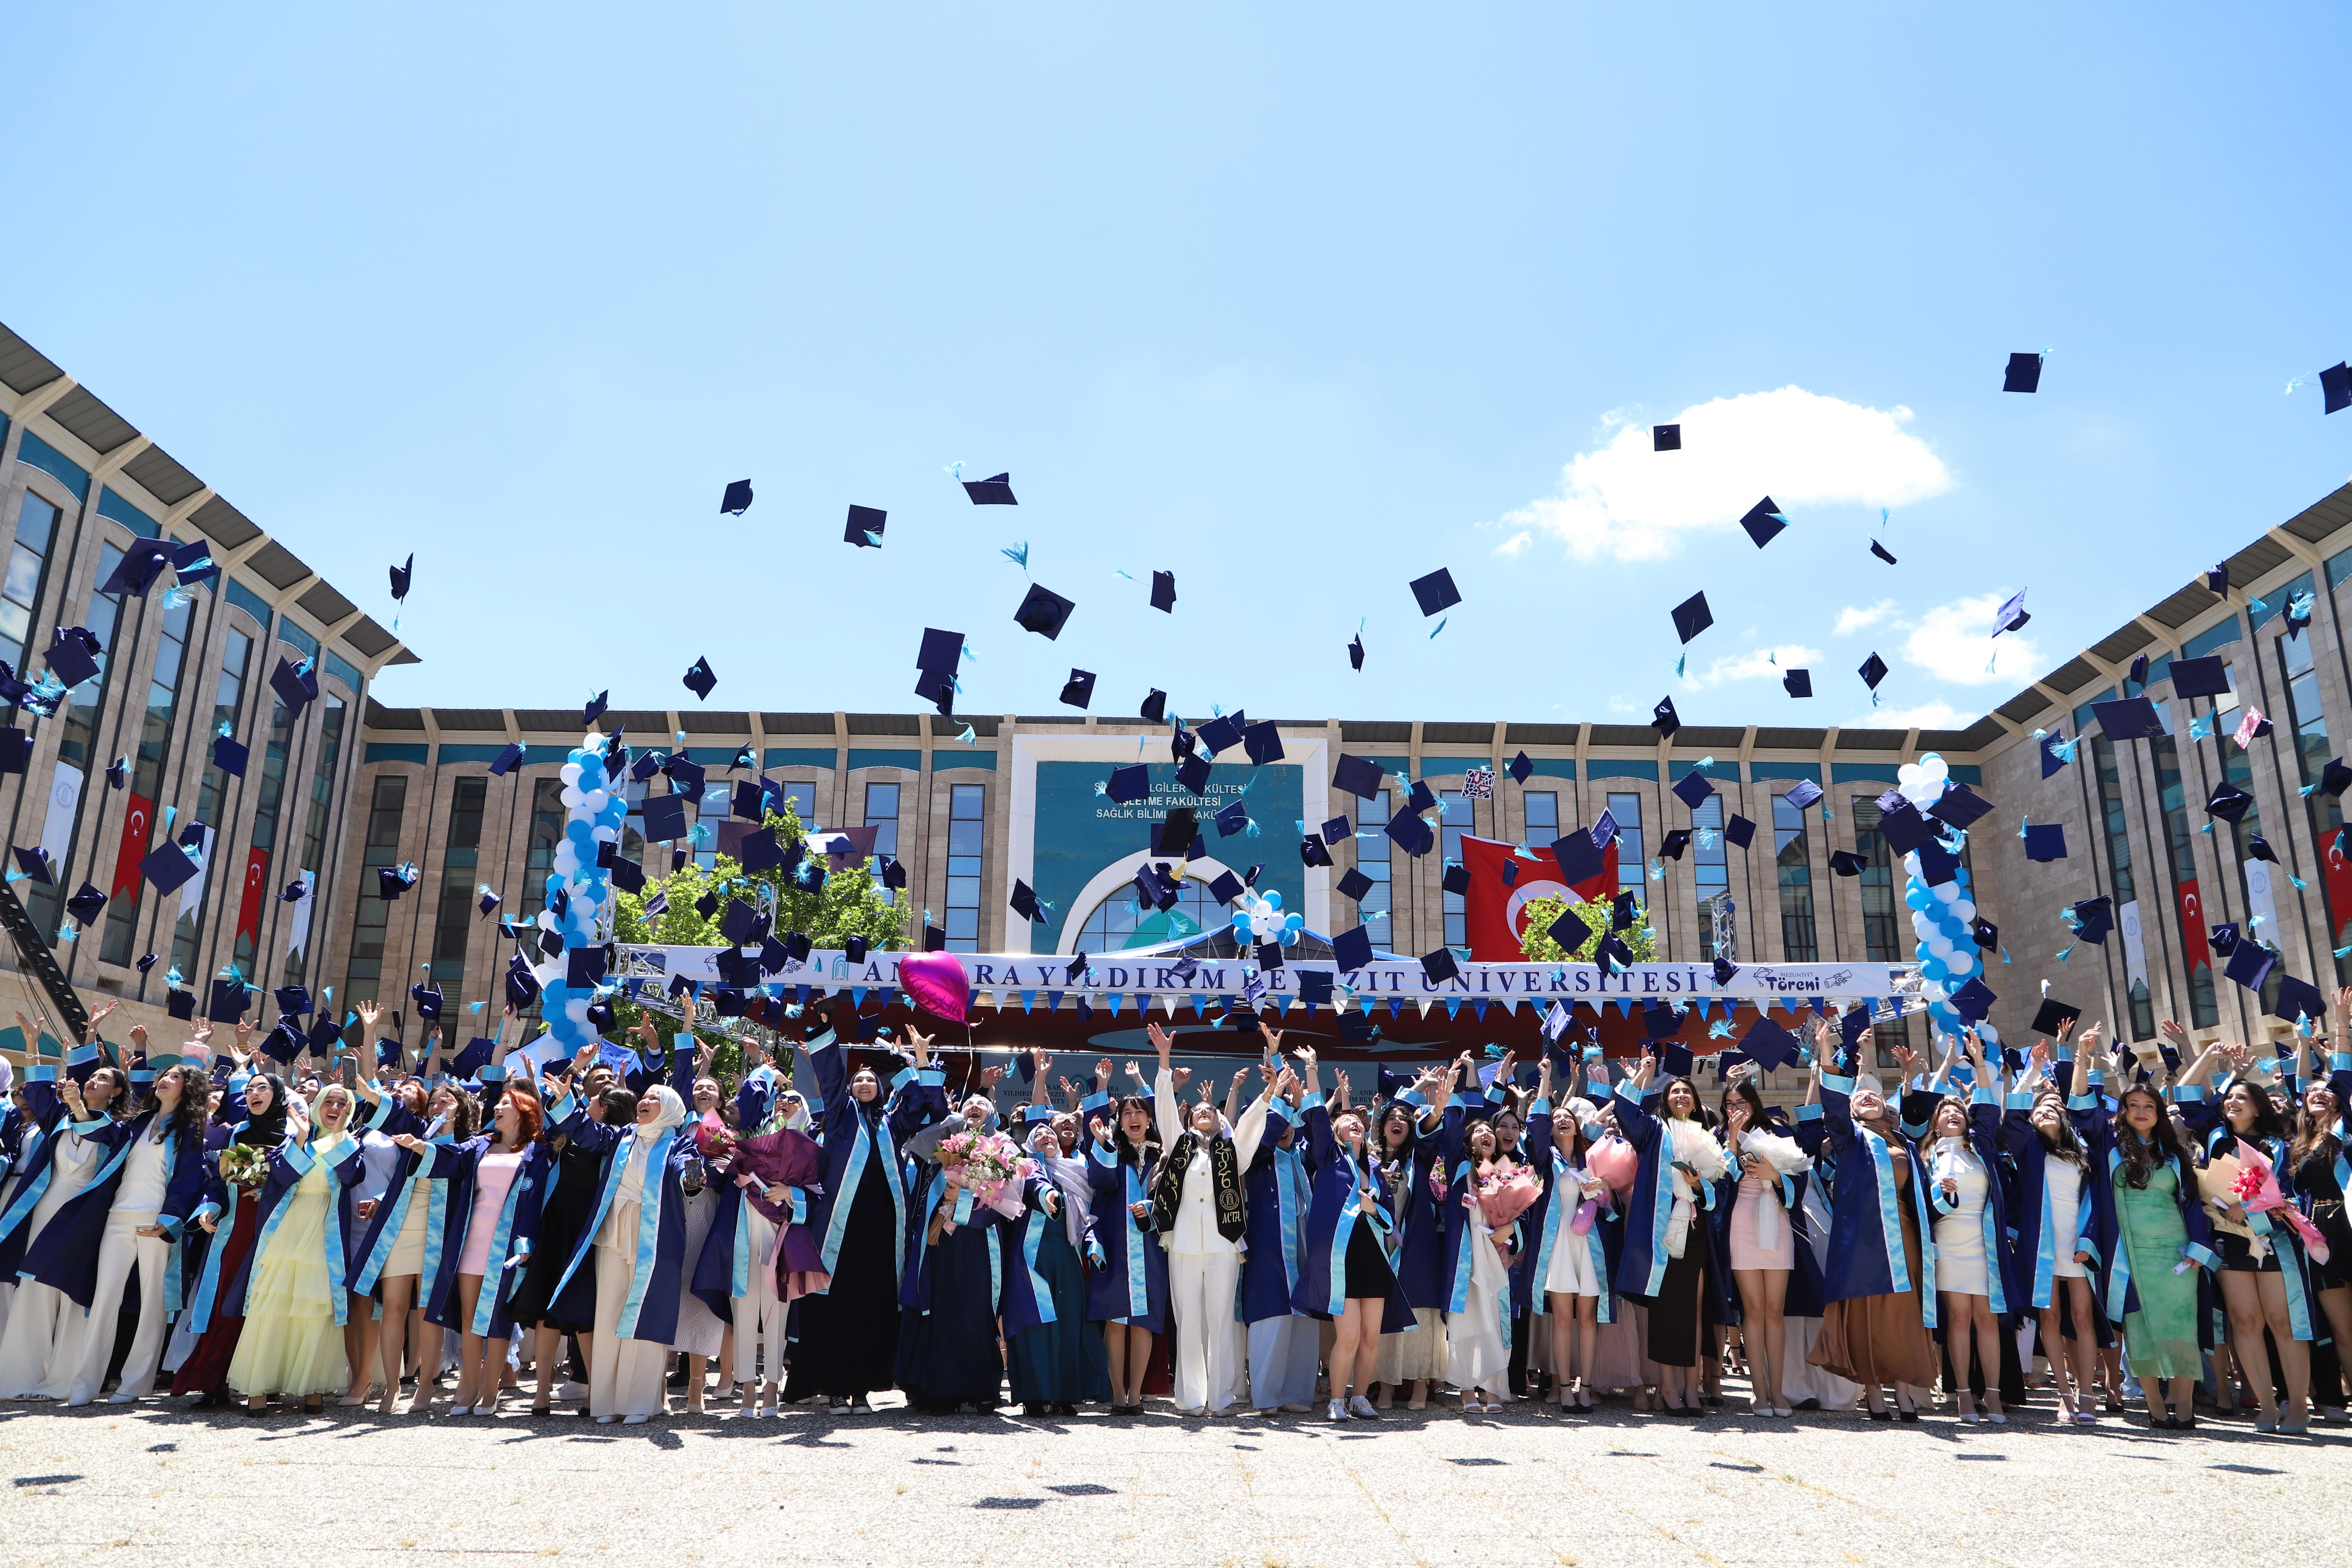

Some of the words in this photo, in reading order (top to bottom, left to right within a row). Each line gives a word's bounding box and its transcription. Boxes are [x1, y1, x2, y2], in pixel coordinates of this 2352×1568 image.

[1150, 782, 1186, 793] LGİLER
[1166, 796, 1221, 806] FAKÜLTESİ
[1096, 807, 1133, 818] SAĞLIK
[1137, 808, 1167, 819] BİLİML
[862, 961, 1022, 985] ARA
[1242, 969, 1405, 991] BEZIT
[1766, 977, 1819, 991] Töreni
[1215, 1141, 1231, 1188] 2026
[1222, 1211, 1242, 1224] MTA
